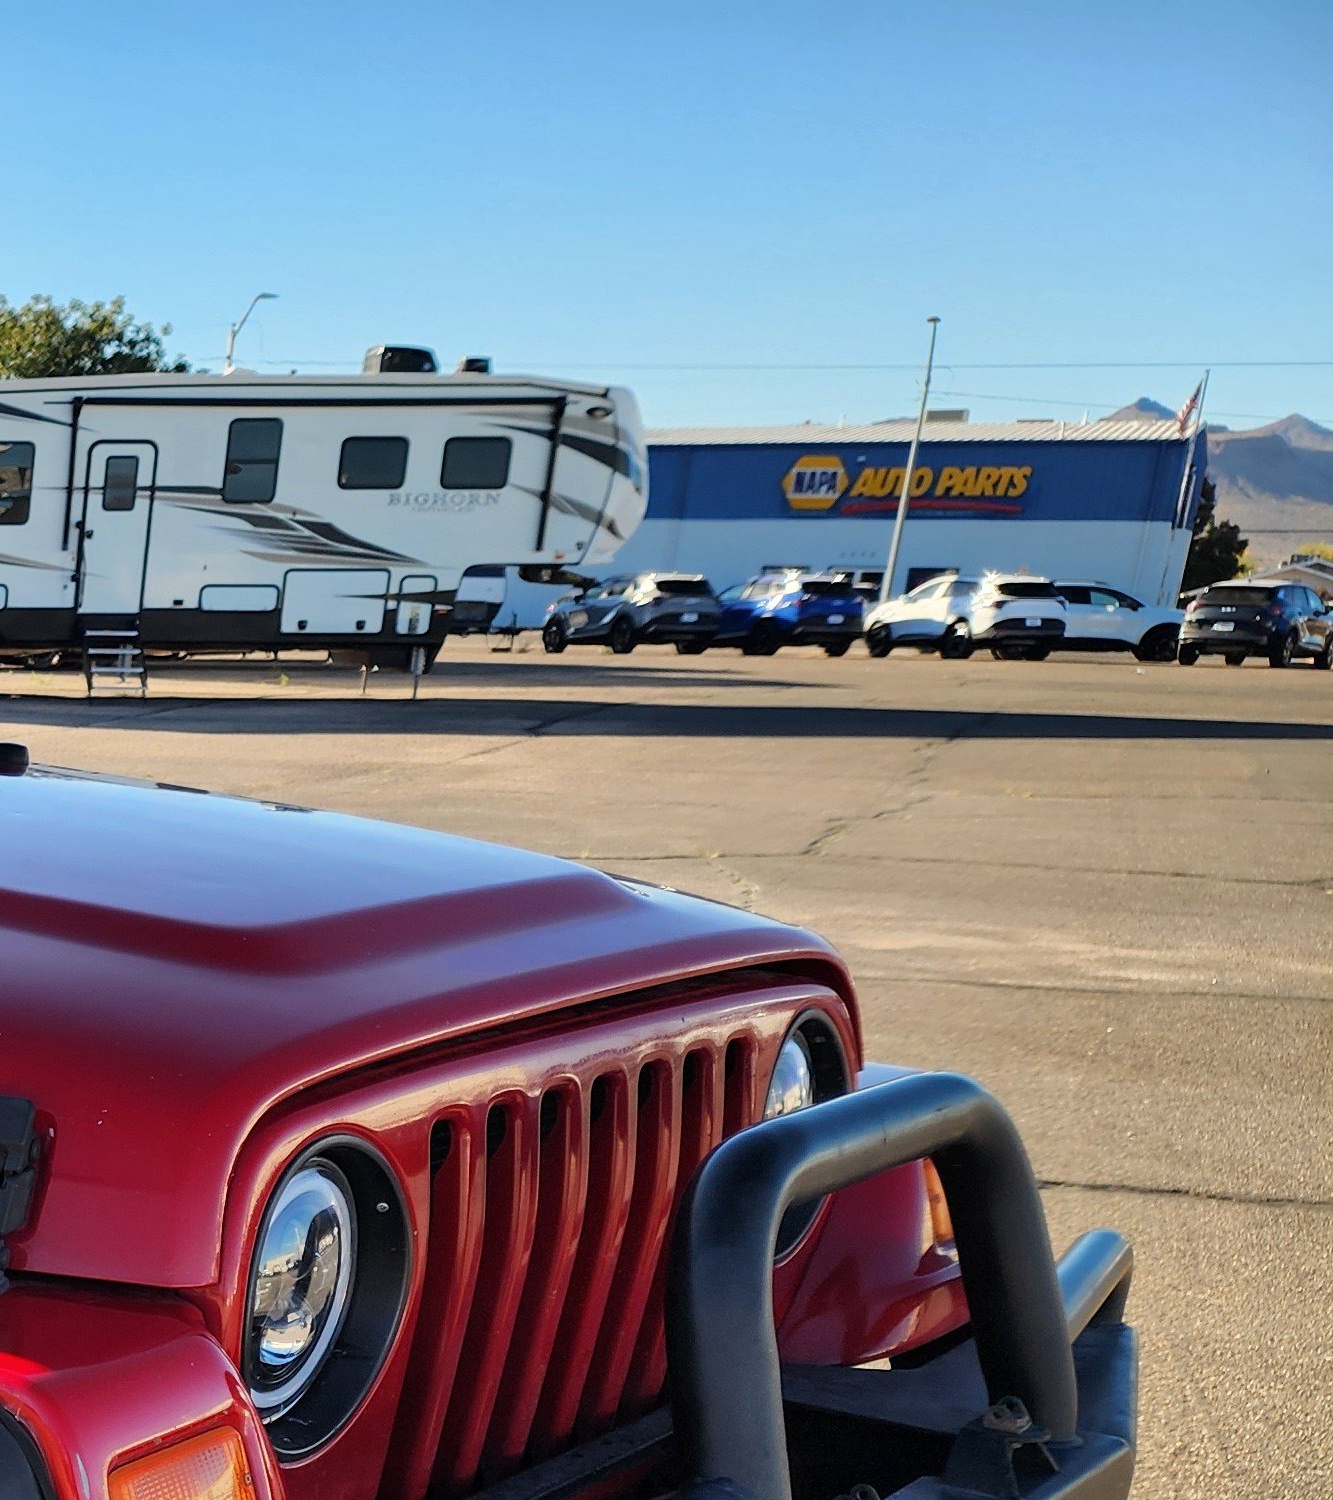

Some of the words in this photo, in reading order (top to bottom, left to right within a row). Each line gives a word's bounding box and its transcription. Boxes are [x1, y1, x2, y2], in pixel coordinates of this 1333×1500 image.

[792, 470, 840, 494] NAPA
[849, 466, 933, 497] AUTO
[935, 466, 1032, 497] PARTS
[387, 492, 501, 507] BIGHORN
